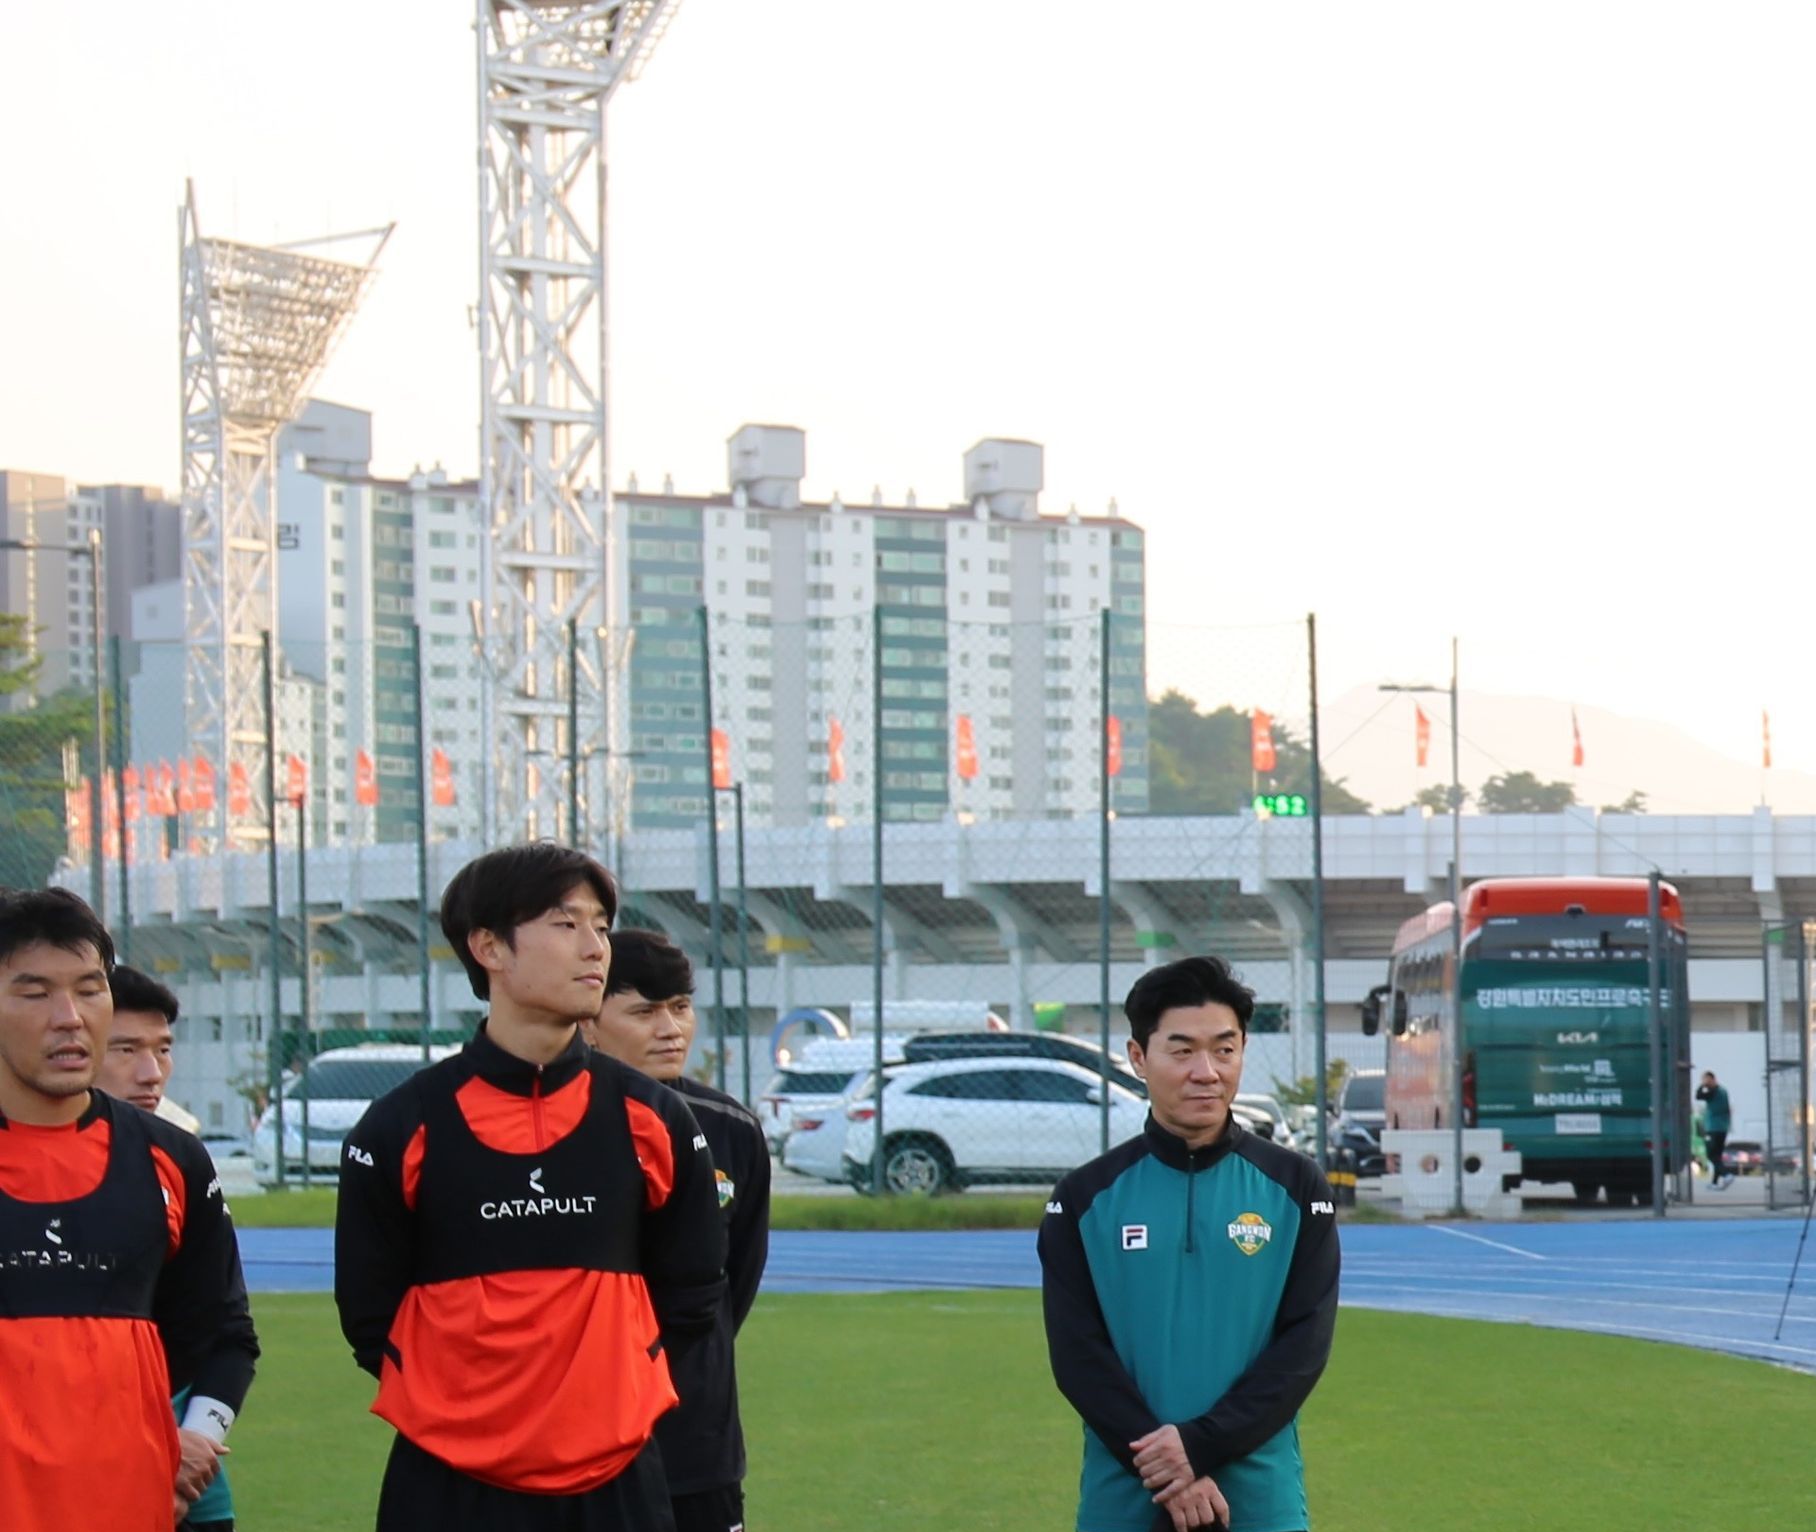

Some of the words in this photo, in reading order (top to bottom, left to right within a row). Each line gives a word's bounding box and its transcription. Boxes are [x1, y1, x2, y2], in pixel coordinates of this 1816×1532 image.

[480, 1196, 596, 1220] CATAPULT
[1311, 1201, 1334, 1215] FILA
[1228, 1223, 1272, 1242] GANGWON
